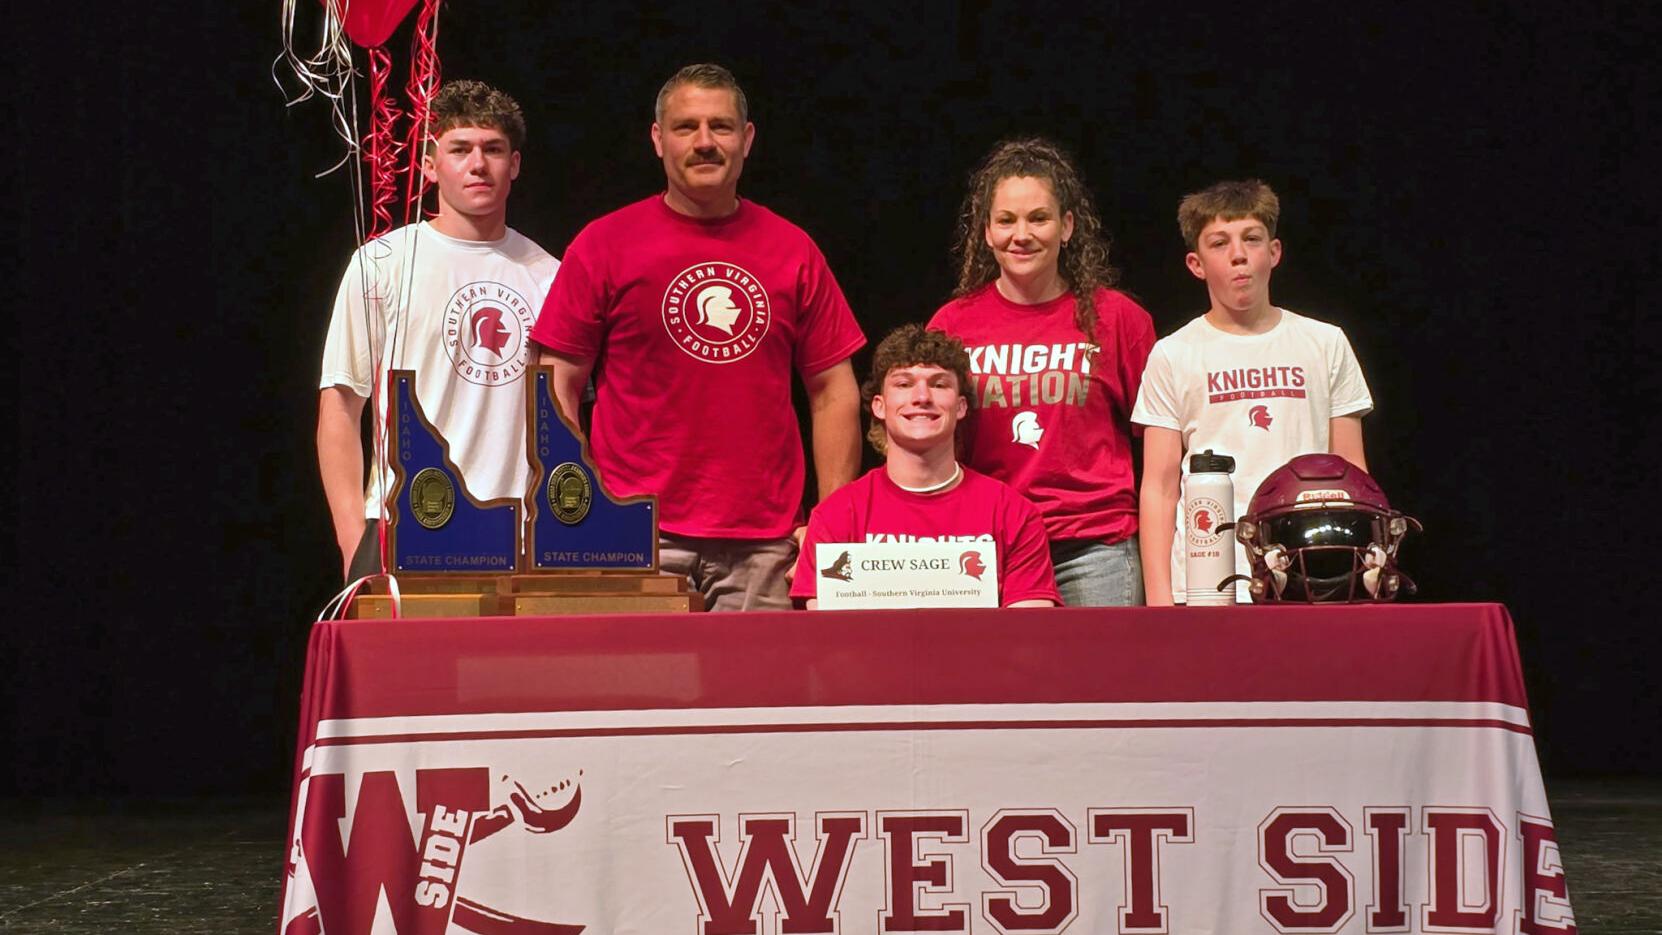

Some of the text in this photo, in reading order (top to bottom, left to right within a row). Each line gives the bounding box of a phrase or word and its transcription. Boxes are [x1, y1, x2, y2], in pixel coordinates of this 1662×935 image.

[669, 267, 766, 325] SOUTHERN VIRGINIA
[448, 287, 487, 347] SOUTHERN
[683, 334, 757, 358] FOOTBALL
[458, 359, 526, 381] FOOTBALL
[1207, 367, 1305, 392] KNIGHTS
[1219, 389, 1296, 400] FOOTBALL
[401, 401, 412, 462] IDAHO
[540, 397, 550, 458] IDAHO
[405, 555, 508, 566] STATE CHAMPION
[544, 552, 645, 562] STATE CHAMPION
[861, 559, 951, 571] CREW SAGE
[909, 589, 941, 598] Virginia
[942, 588, 981, 597] University
[415, 805, 468, 909] SIDE
[666, 806, 1578, 935] WEST SIDE
